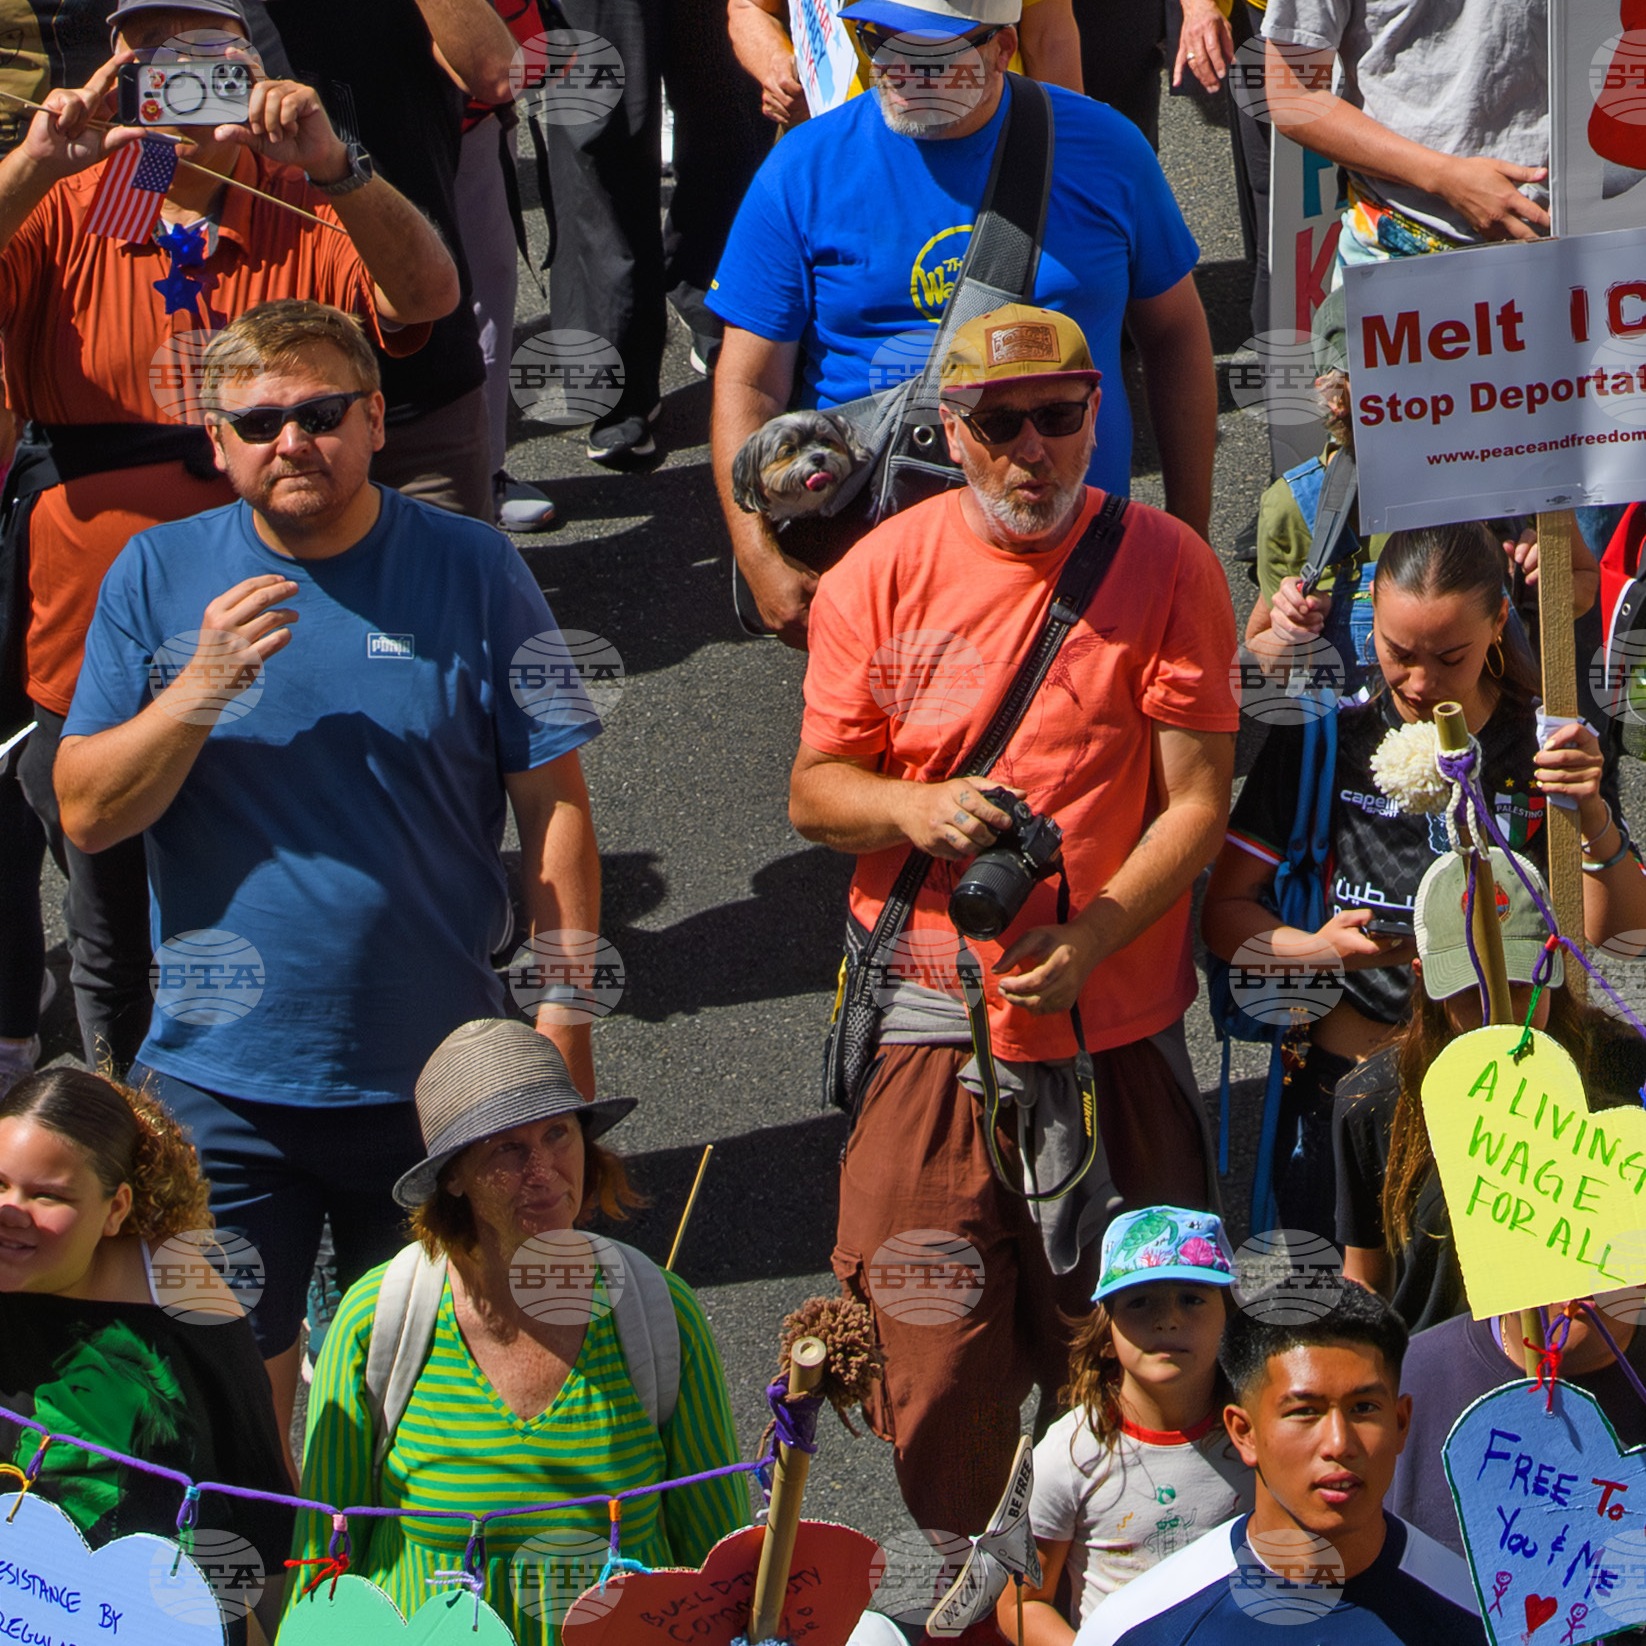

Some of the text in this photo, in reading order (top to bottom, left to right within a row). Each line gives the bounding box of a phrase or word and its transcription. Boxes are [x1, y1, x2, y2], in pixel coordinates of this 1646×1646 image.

[1360, 296, 1525, 369] Melt
[1358, 385, 1453, 429] Stop
[1467, 1059, 1500, 1104] A
[1467, 1118, 1604, 1212] WAGE
[1467, 1180, 1629, 1287] FOR ALL
[1477, 1431, 1579, 1506] FREE
